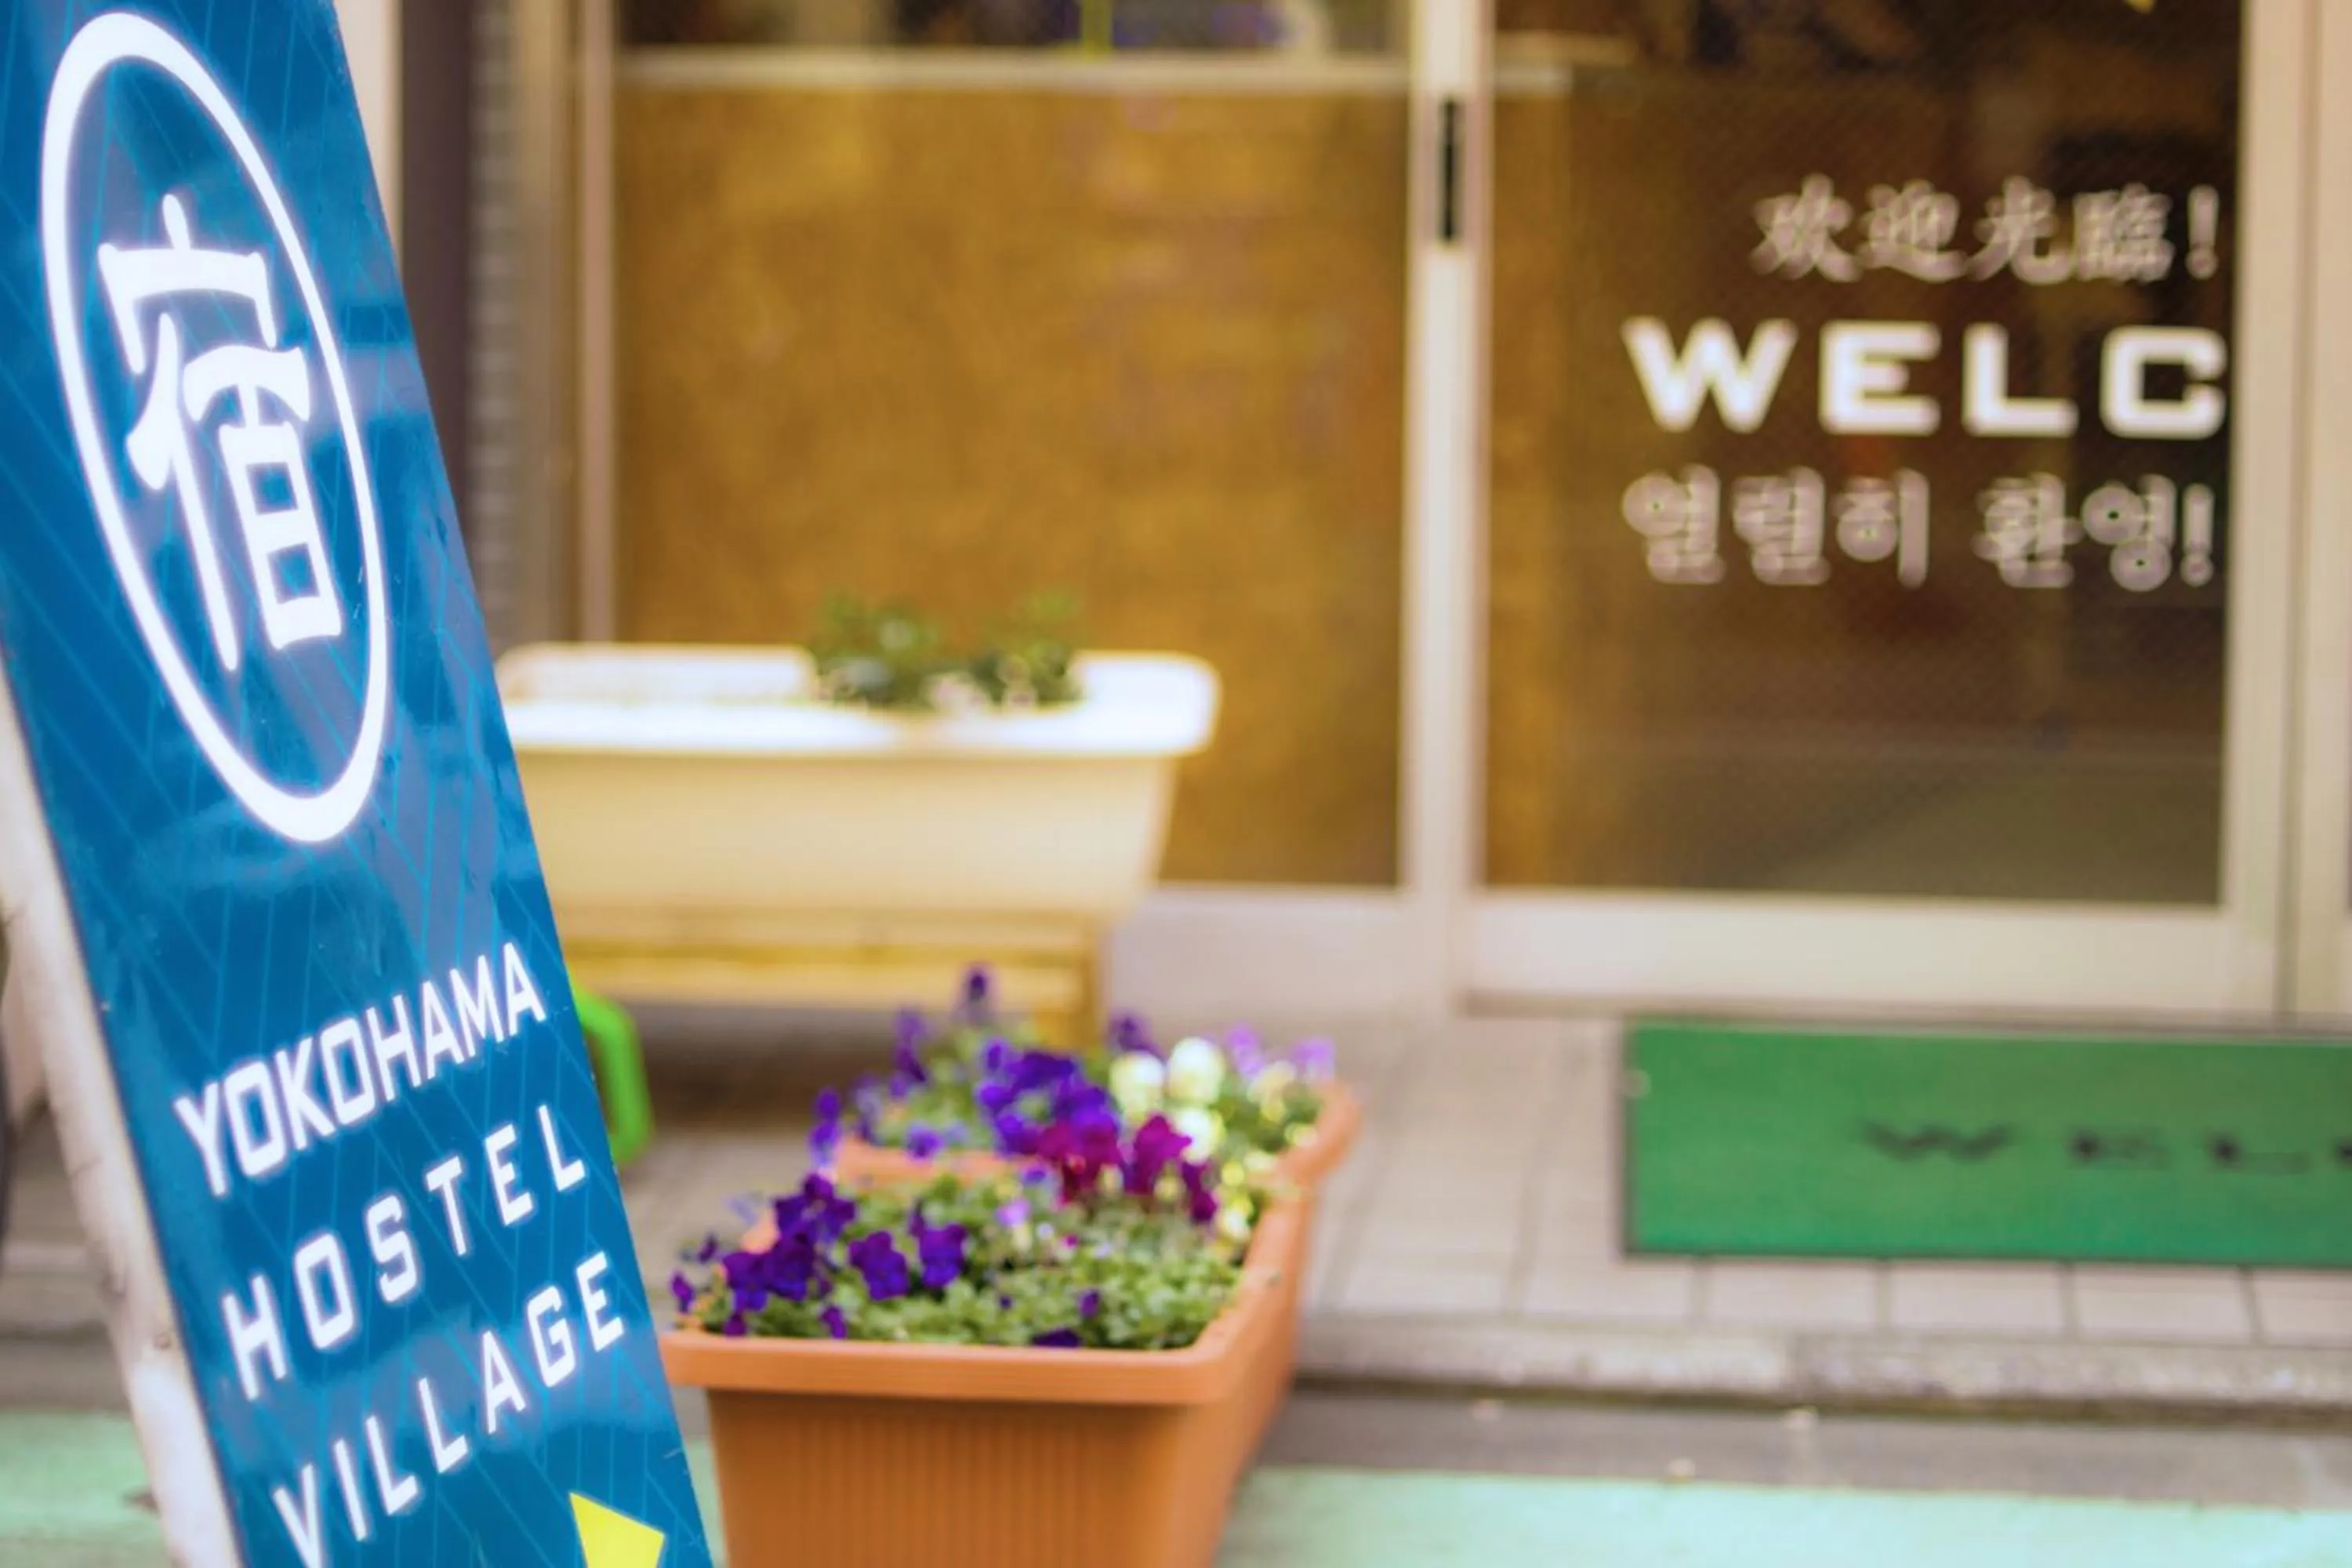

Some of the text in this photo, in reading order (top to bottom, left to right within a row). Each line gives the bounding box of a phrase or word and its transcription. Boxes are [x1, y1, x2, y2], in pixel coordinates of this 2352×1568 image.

[98, 194, 342, 670] 宿
[1621, 318, 2226, 440] WELC
[1621, 464, 2213, 592] 열렬히 환영!
[173, 942, 546, 1197] YOKOHAMA
[222, 1105, 585, 1400] HOSTEL
[273, 1251, 624, 1568] VILLAGE
